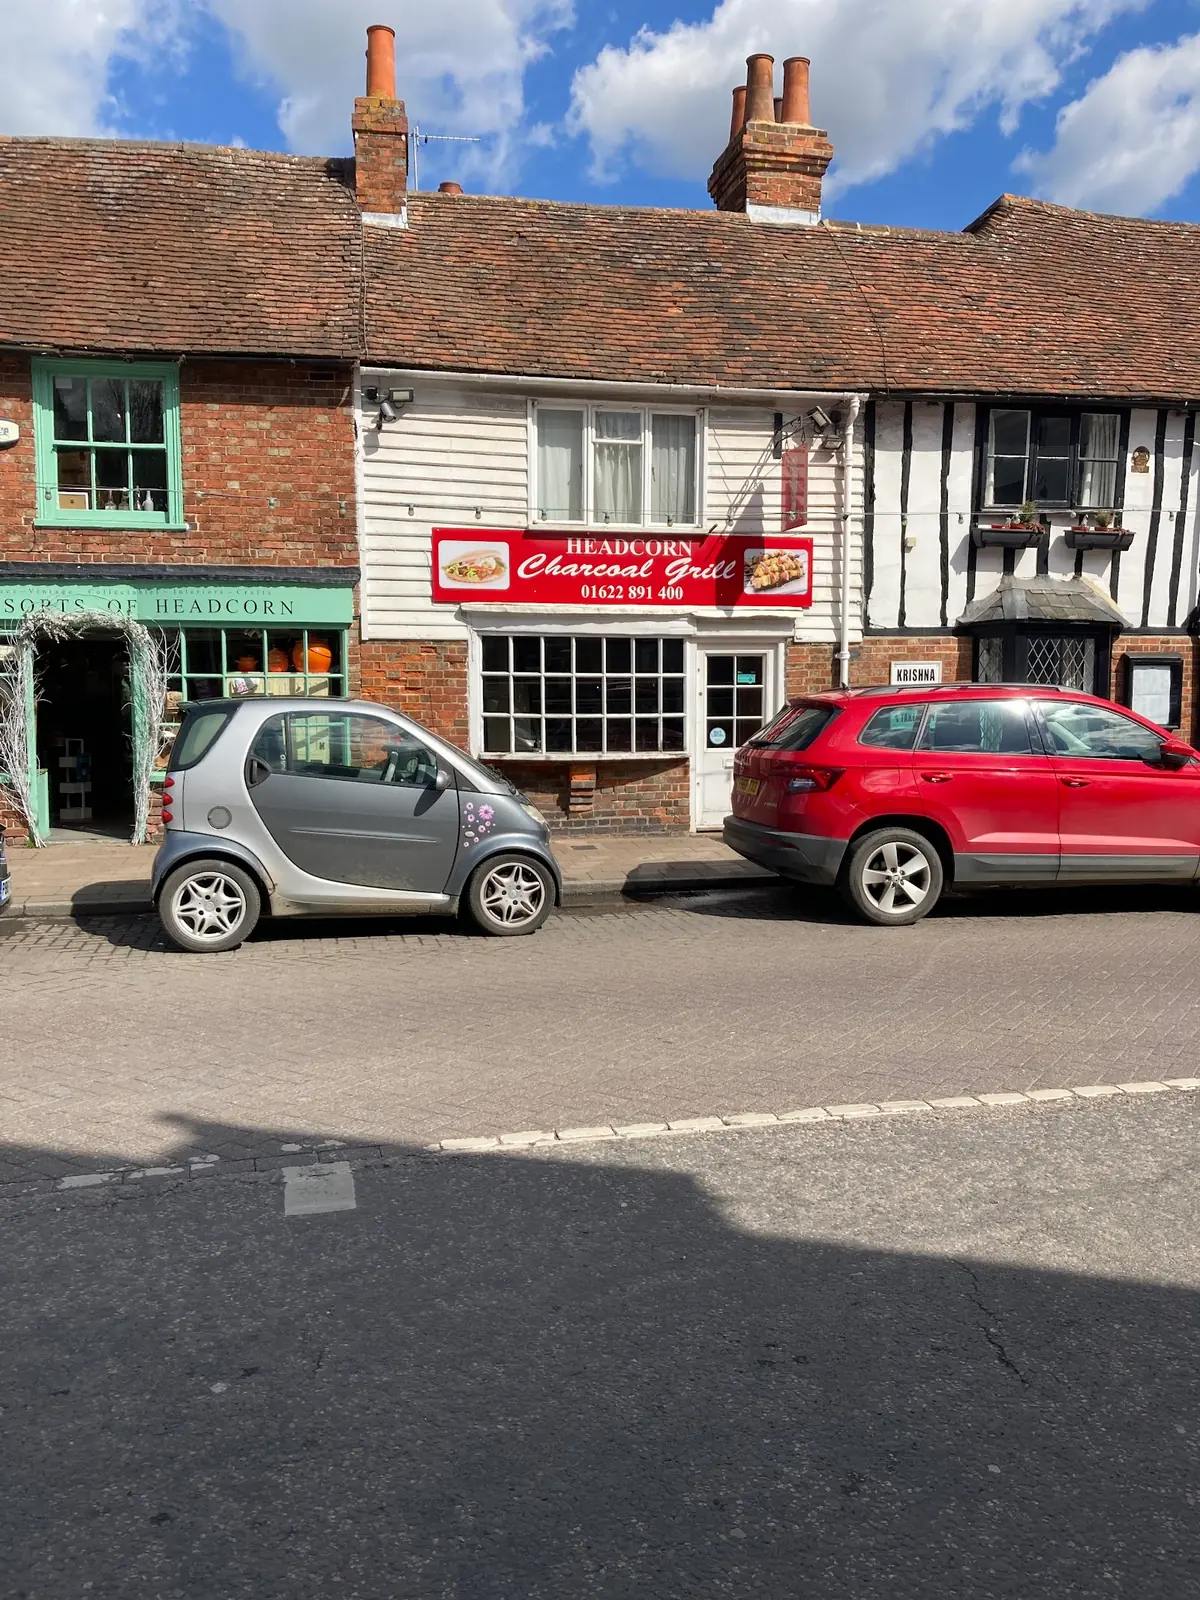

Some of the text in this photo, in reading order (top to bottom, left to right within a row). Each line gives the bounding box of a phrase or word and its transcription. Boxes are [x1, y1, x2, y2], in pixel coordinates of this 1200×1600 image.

[566, 537, 692, 557] HEADCORN
[517, 553, 737, 586] Charcoal Grill
[581, 585, 684, 600] 01622 891 400
[4, 598, 294, 615] SORTS OF HEADCORN
[896, 668, 936, 682] KRISHNA
